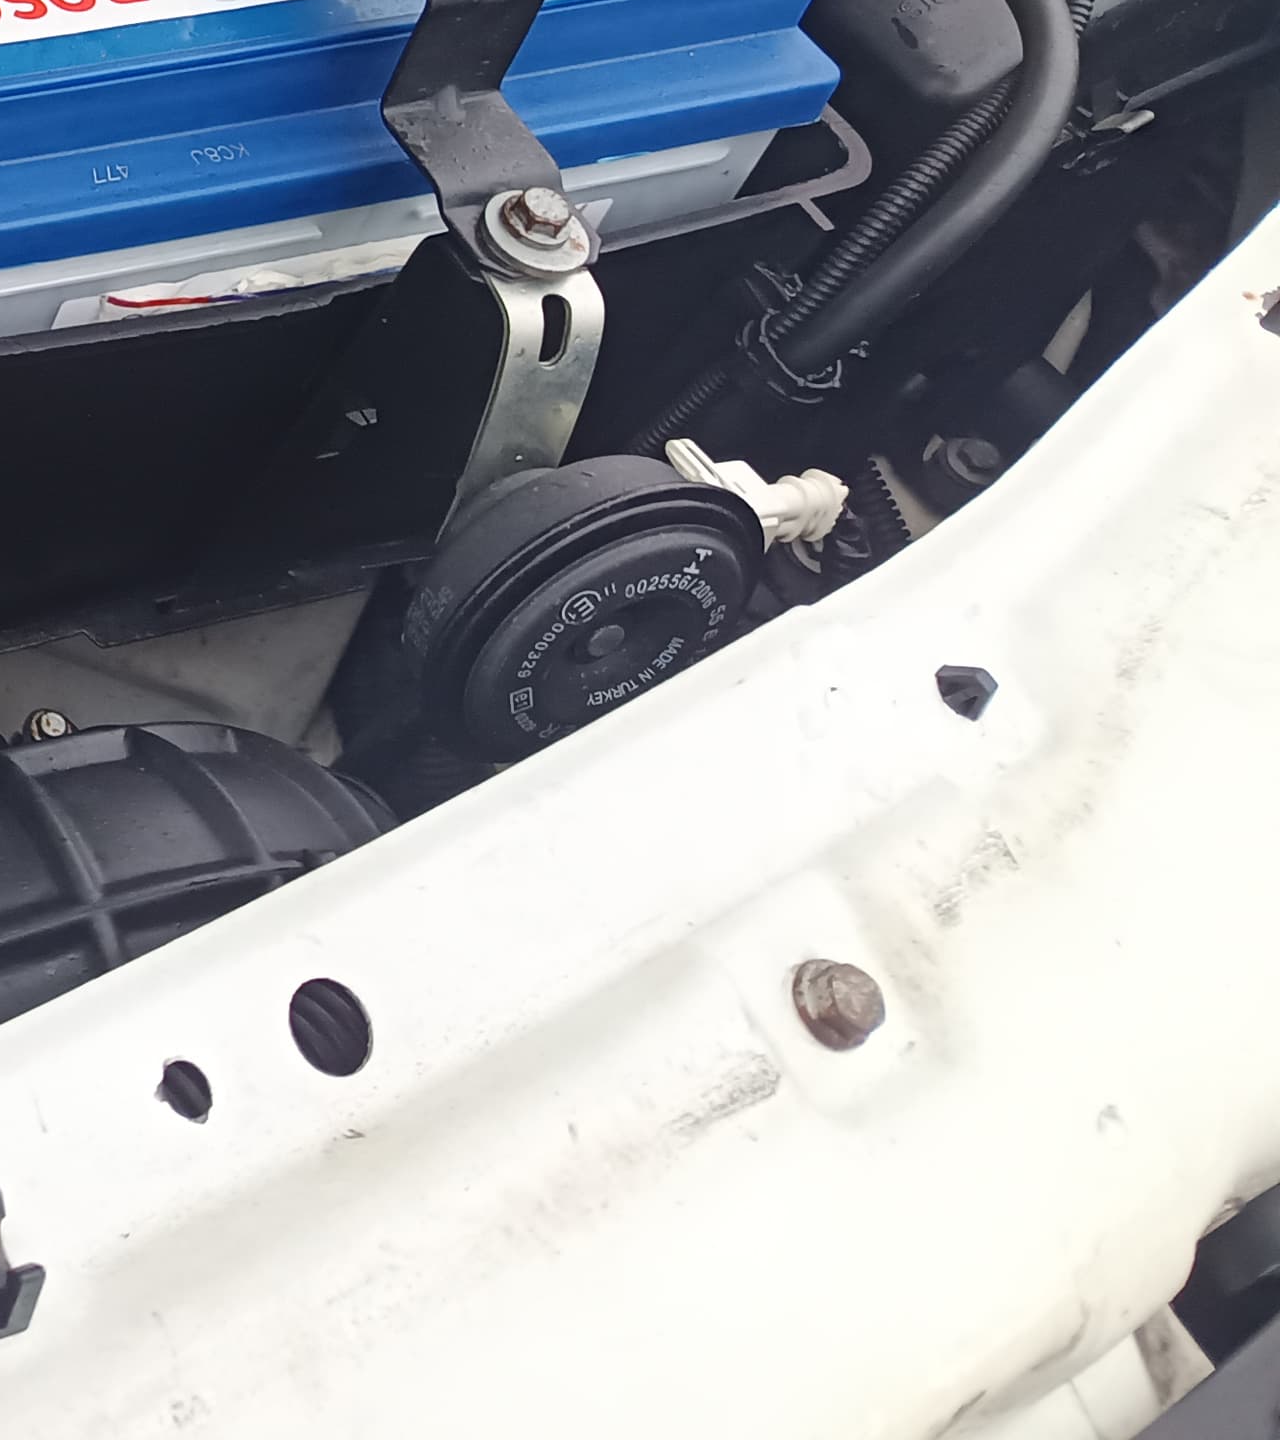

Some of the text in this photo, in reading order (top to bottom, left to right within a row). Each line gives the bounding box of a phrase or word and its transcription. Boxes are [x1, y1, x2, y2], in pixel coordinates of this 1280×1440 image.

[517, 621, 565, 680] 000329
[586, 636, 686, 707] MADE IN TURKEY
